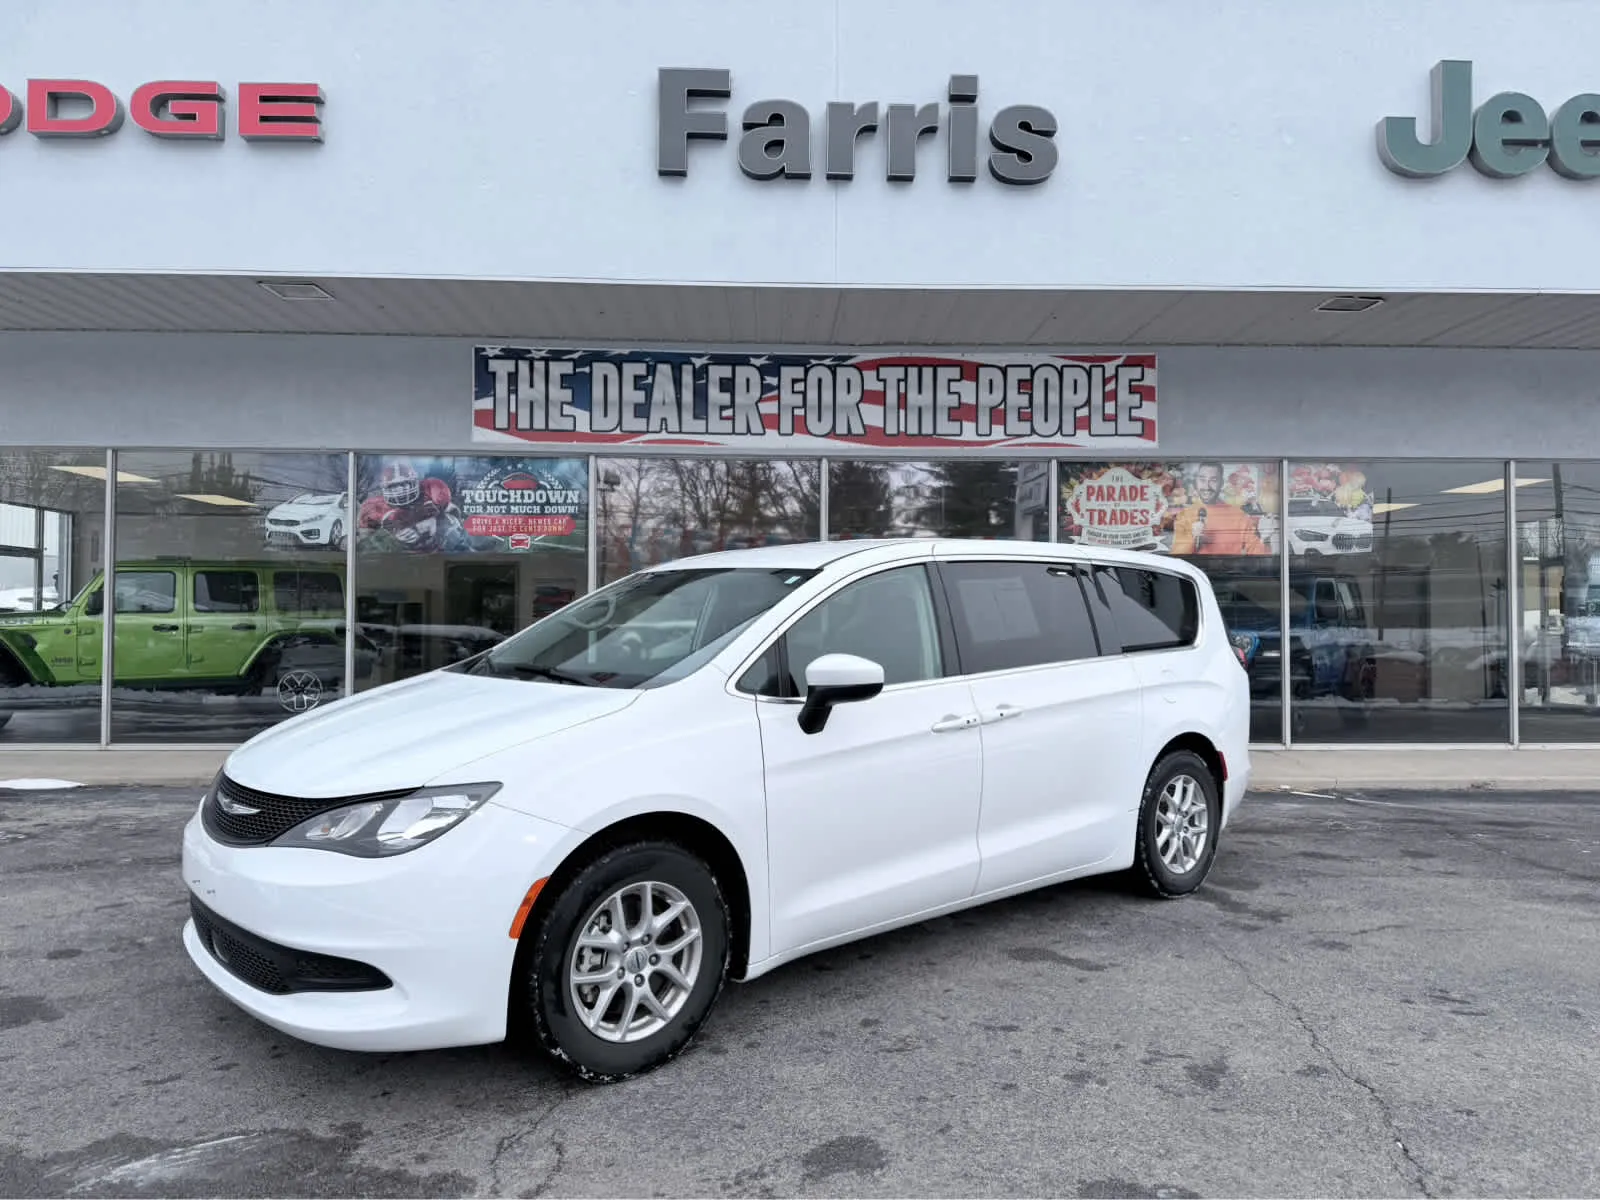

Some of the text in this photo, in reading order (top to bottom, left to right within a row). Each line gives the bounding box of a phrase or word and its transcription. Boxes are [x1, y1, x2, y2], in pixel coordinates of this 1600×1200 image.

[0, 78, 323, 143] DGE
[657, 68, 1058, 185] Farris
[487, 358, 1146, 438] THE DEALER FOR THE PEOPLE
[461, 489, 580, 504] TOUCHDOWN
[1086, 485, 1149, 501] PARADE
[463, 505, 579, 514] FOR NOT MUCH DOWN!
[1086, 508, 1149, 525] TRADES
